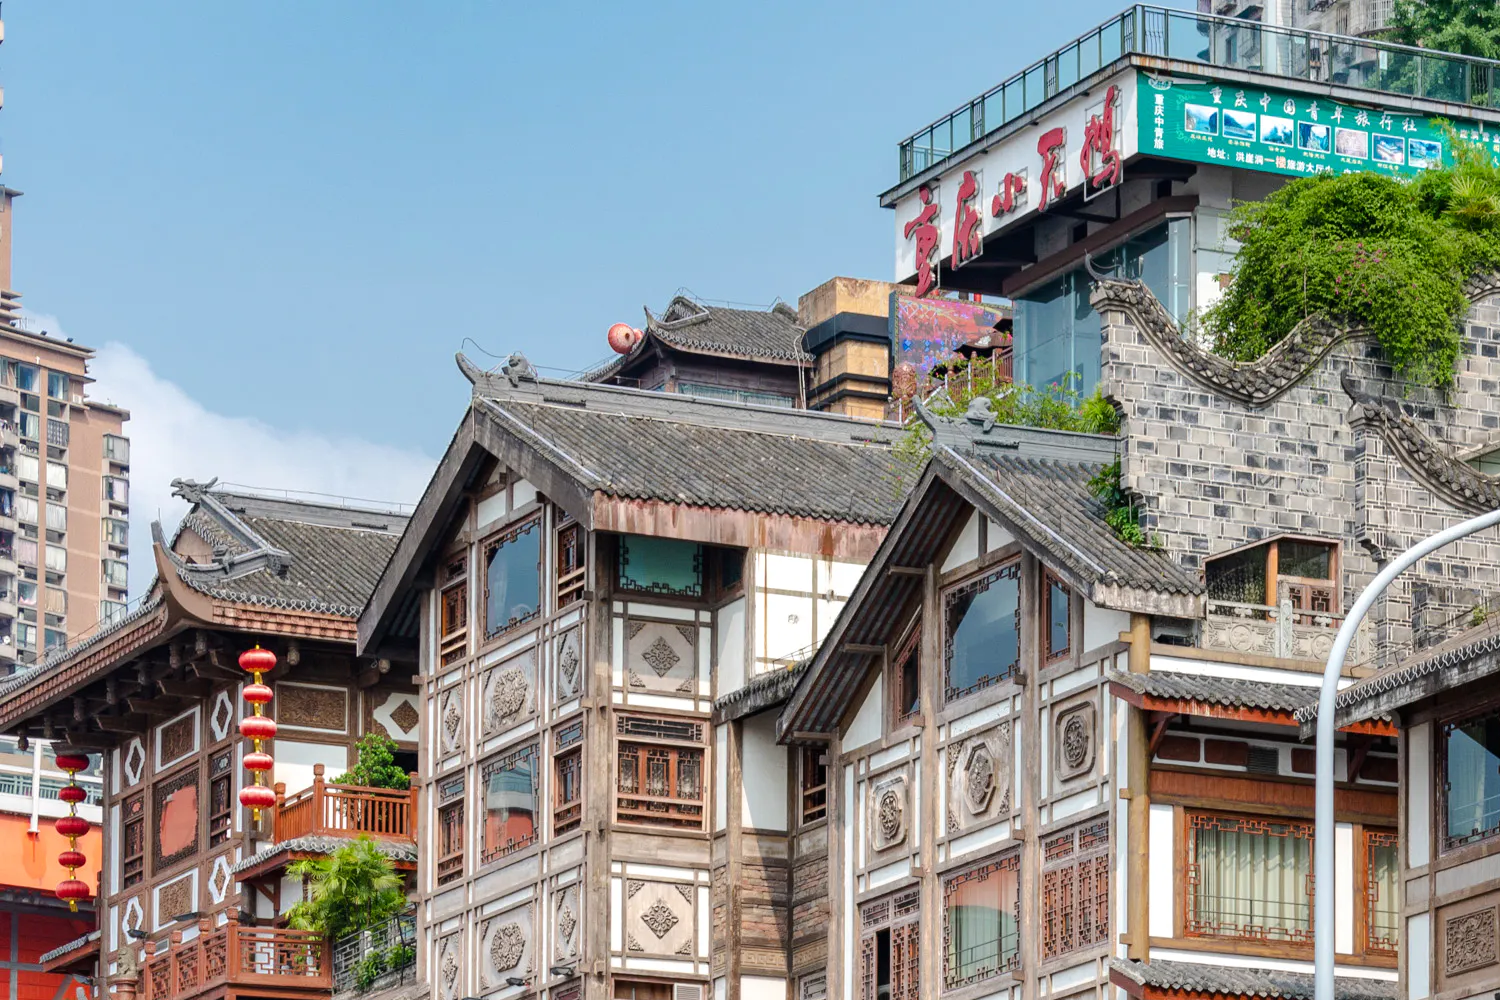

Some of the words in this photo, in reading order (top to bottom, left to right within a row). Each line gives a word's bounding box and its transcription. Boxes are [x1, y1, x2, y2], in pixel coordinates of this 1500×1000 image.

[1153, 93, 1165, 150] 重庆中青旅
[1209, 86, 1417, 132] 重庆中国青年旅行社
